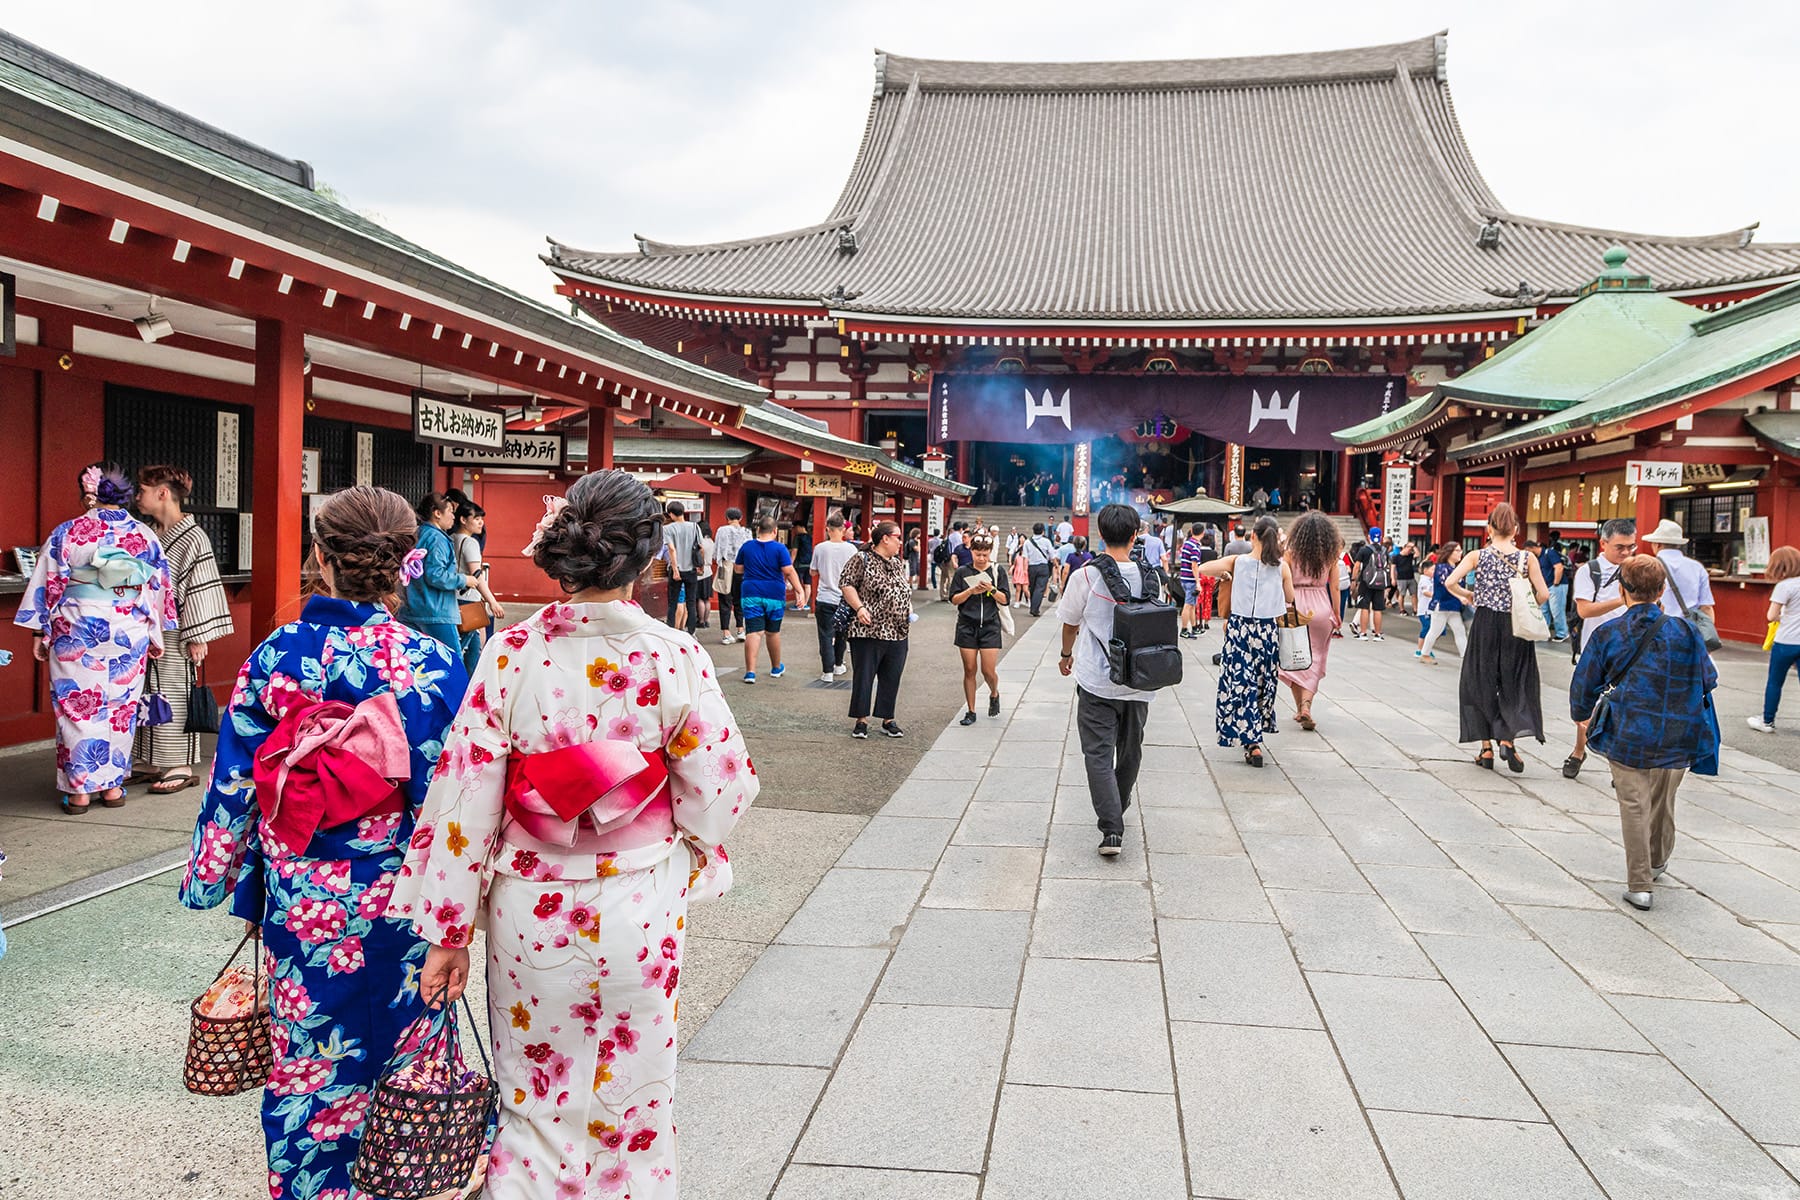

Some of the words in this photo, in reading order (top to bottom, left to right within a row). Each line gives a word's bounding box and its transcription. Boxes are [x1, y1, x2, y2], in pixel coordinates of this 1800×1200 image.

[420, 404, 498, 441] 古札お納め所
[1645, 466, 1679, 481] 朱印所
